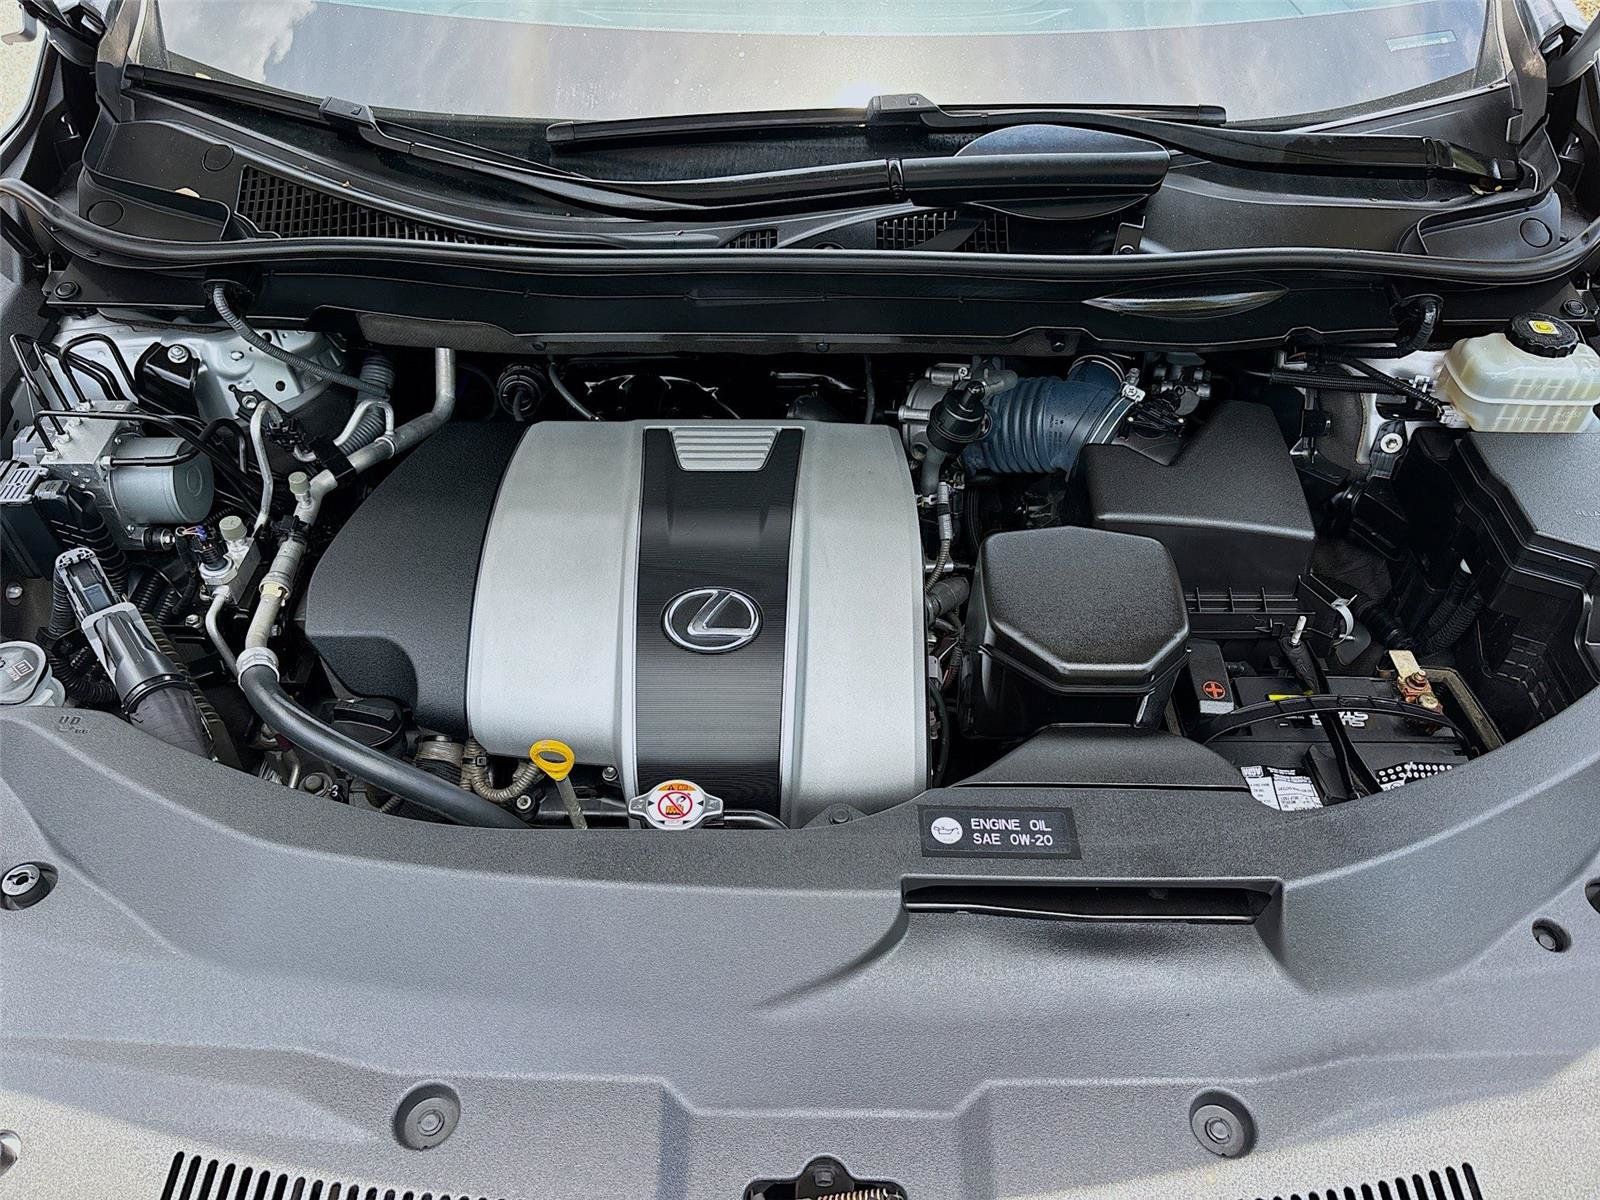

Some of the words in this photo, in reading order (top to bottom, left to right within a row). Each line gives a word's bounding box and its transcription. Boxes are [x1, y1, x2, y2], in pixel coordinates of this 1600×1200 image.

[970, 818, 1021, 831] ENGINE
[1029, 819, 1052, 832] OIL
[973, 832, 1001, 845] SAE
[1010, 834, 1053, 846] 0W-20
